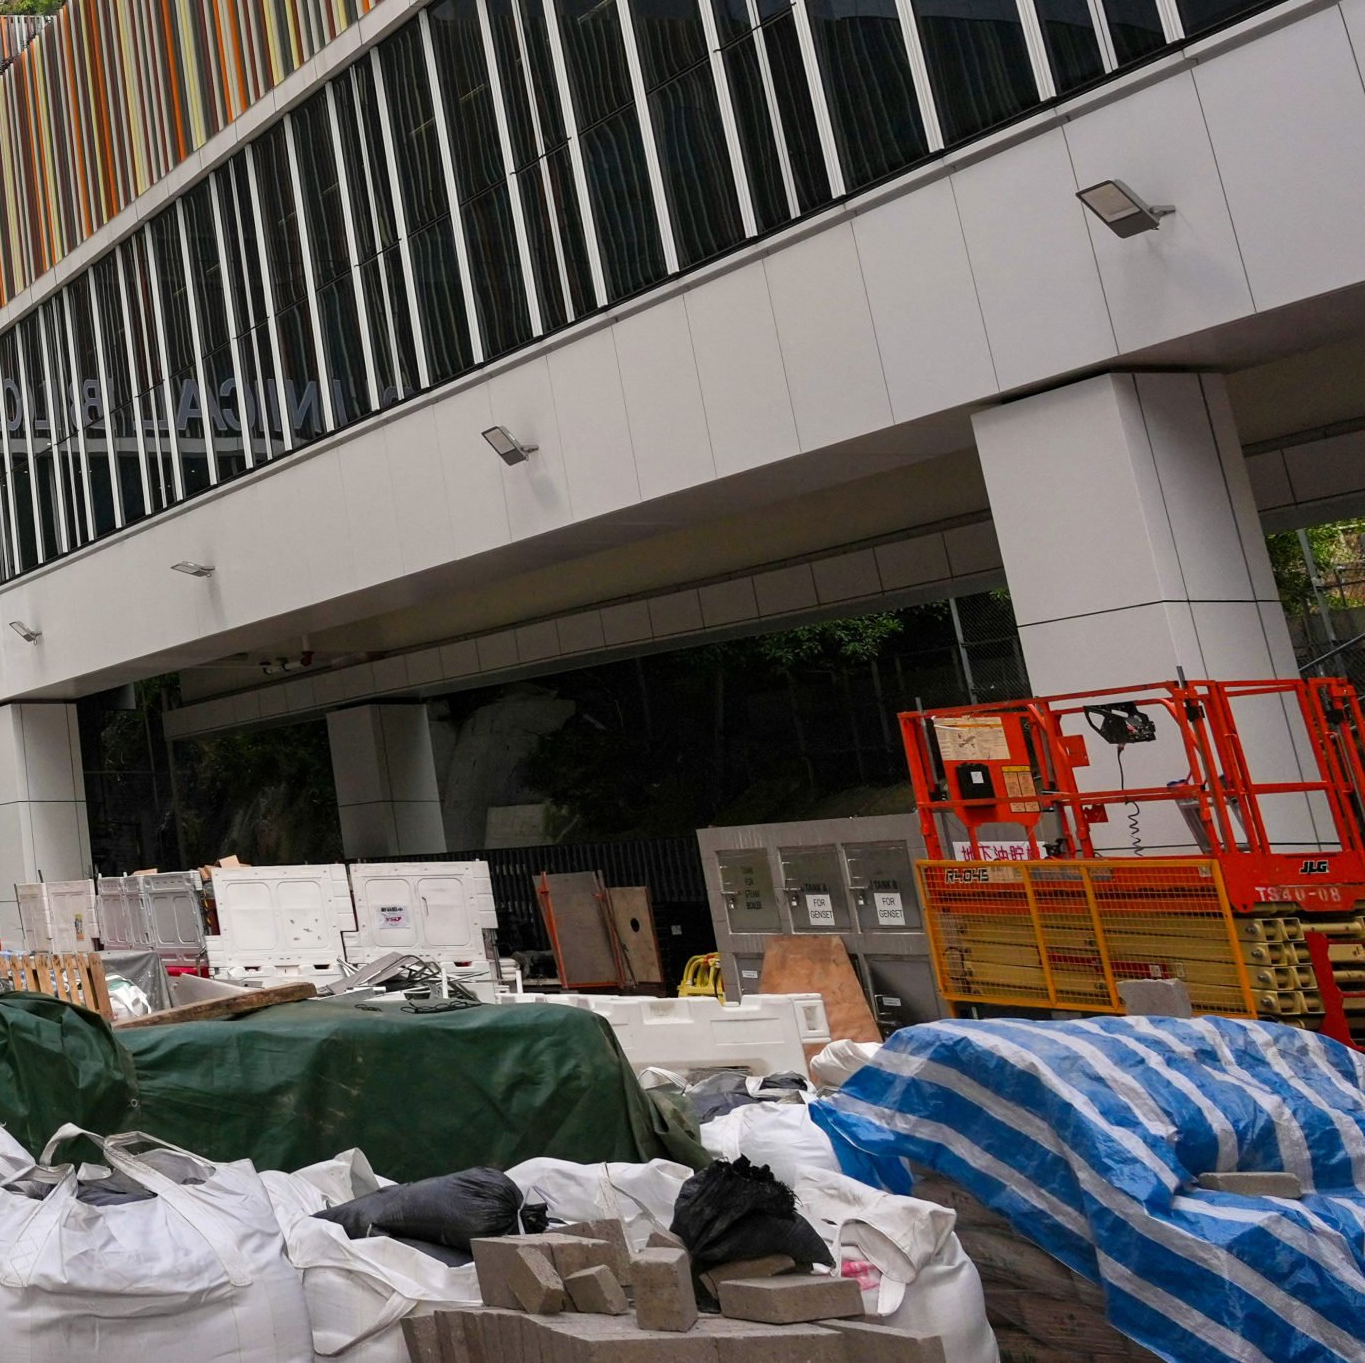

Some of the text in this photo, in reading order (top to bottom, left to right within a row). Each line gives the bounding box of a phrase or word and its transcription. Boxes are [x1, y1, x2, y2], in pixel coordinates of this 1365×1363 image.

[1299, 860, 1329, 874] JLG
[813, 898, 825, 906] FOR
[882, 897, 895, 905] FOR
[879, 909, 903, 918] GENSET
